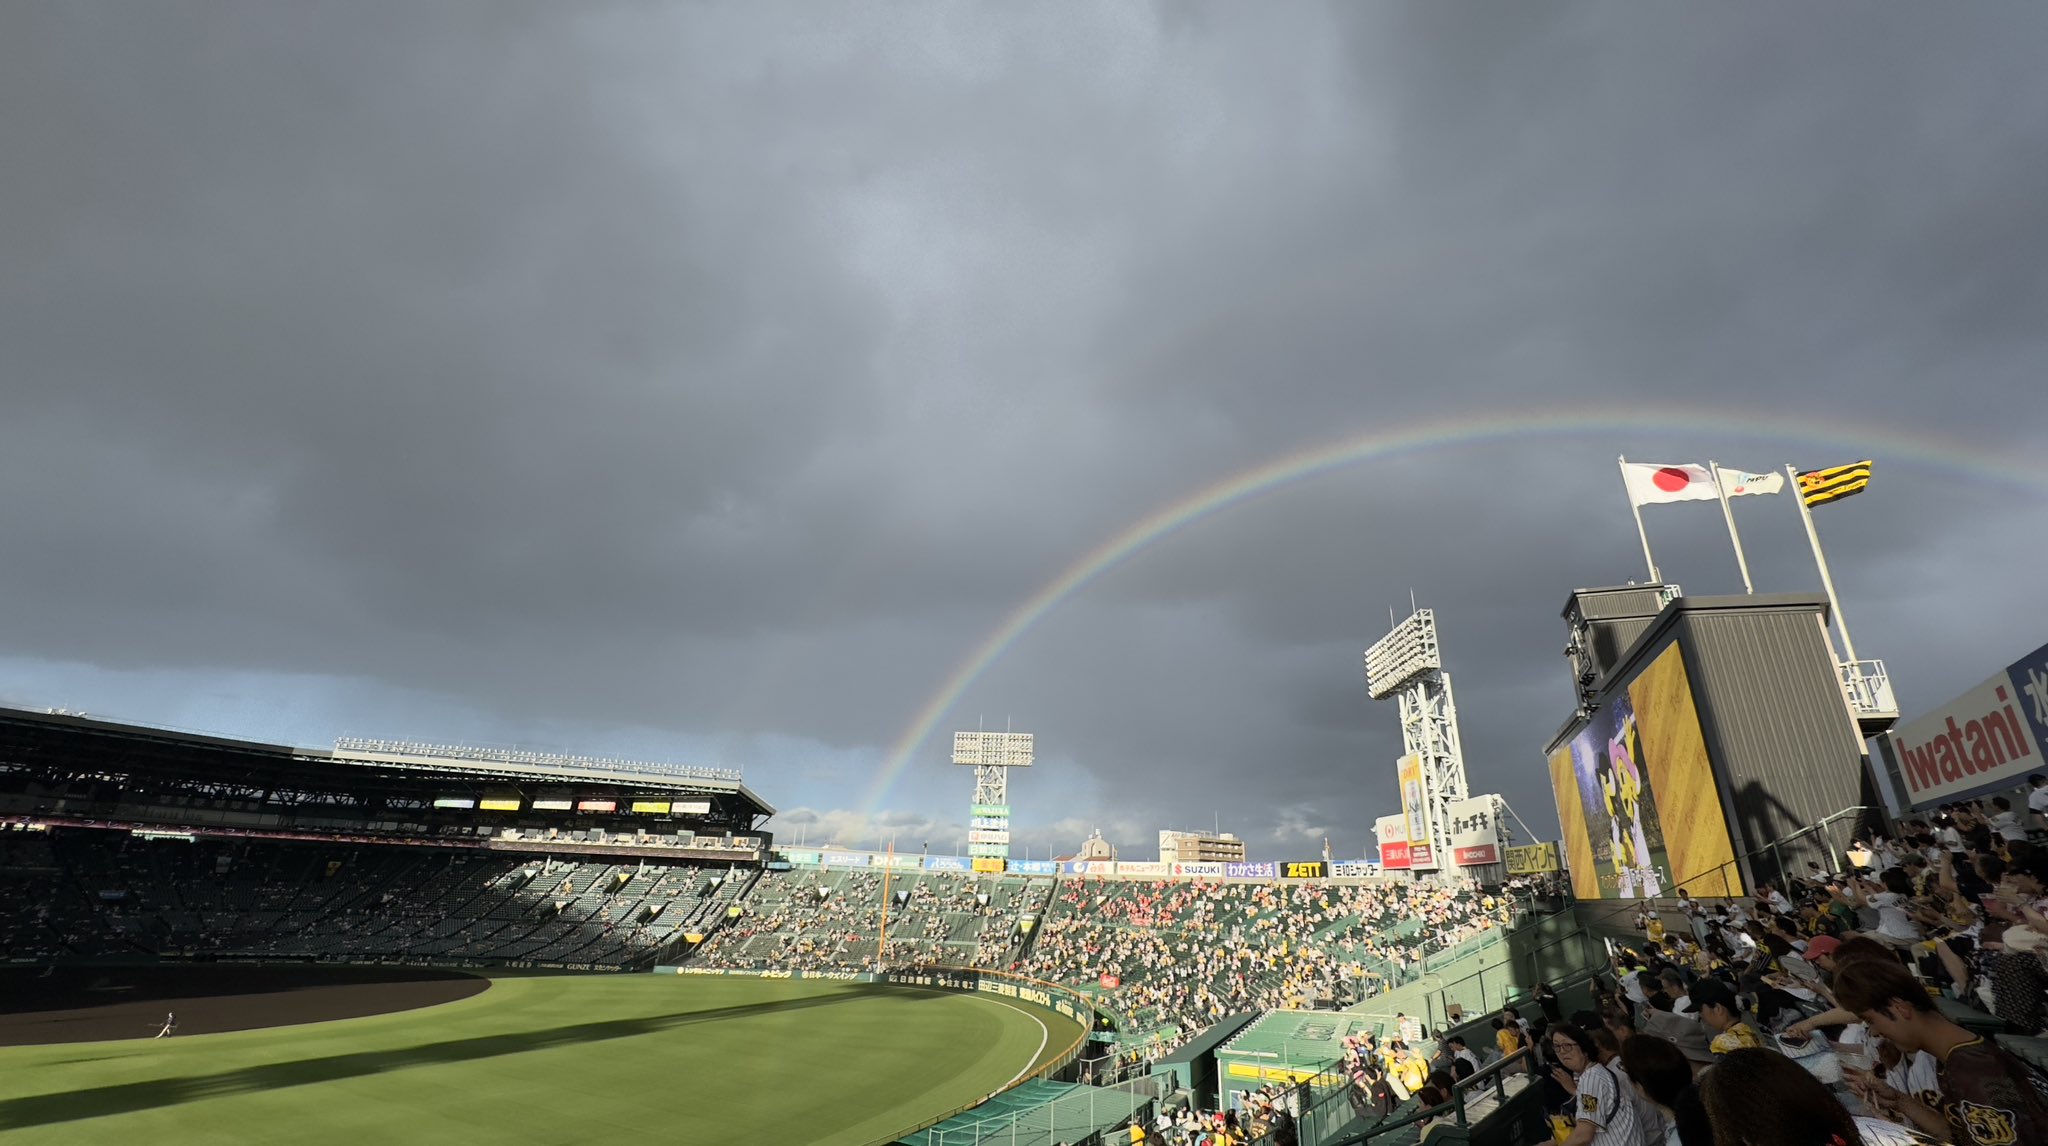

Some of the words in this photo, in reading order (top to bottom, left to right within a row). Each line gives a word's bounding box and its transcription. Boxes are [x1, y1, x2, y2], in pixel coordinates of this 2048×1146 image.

[1896, 685, 2030, 793] Iwatani
[1453, 812, 1488, 835] ホーチキ
[830, 855, 860, 865] エスリード
[1506, 845, 1555, 871] 関西ペイント
[1184, 865, 1220, 874] SUZUKI
[1227, 863, 1274, 877] わかさ生活
[1286, 862, 1321, 878] ZETT
[946, 979, 974, 989] 住友電工
